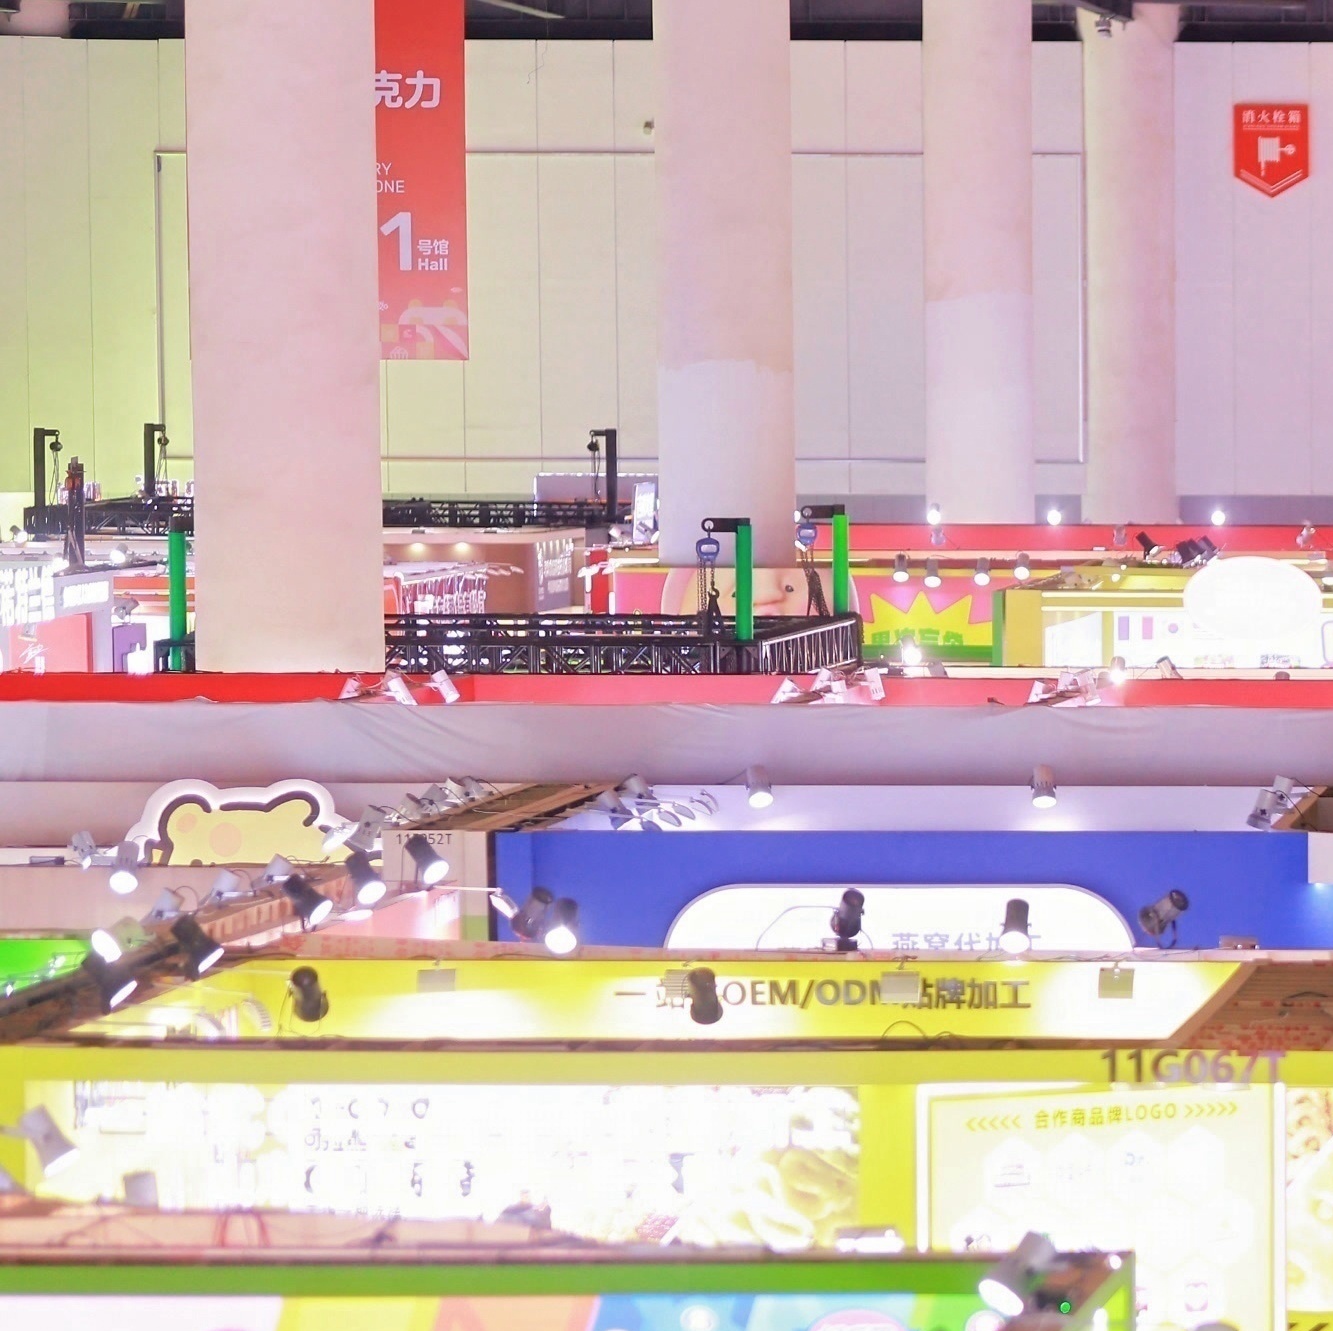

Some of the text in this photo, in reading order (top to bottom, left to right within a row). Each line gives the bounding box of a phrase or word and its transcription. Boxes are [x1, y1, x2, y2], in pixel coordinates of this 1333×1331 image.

[417, 239, 449, 255] 号馆
[418, 258, 447, 271] Hall
[1101, 1049, 1287, 1083] 11G067T
